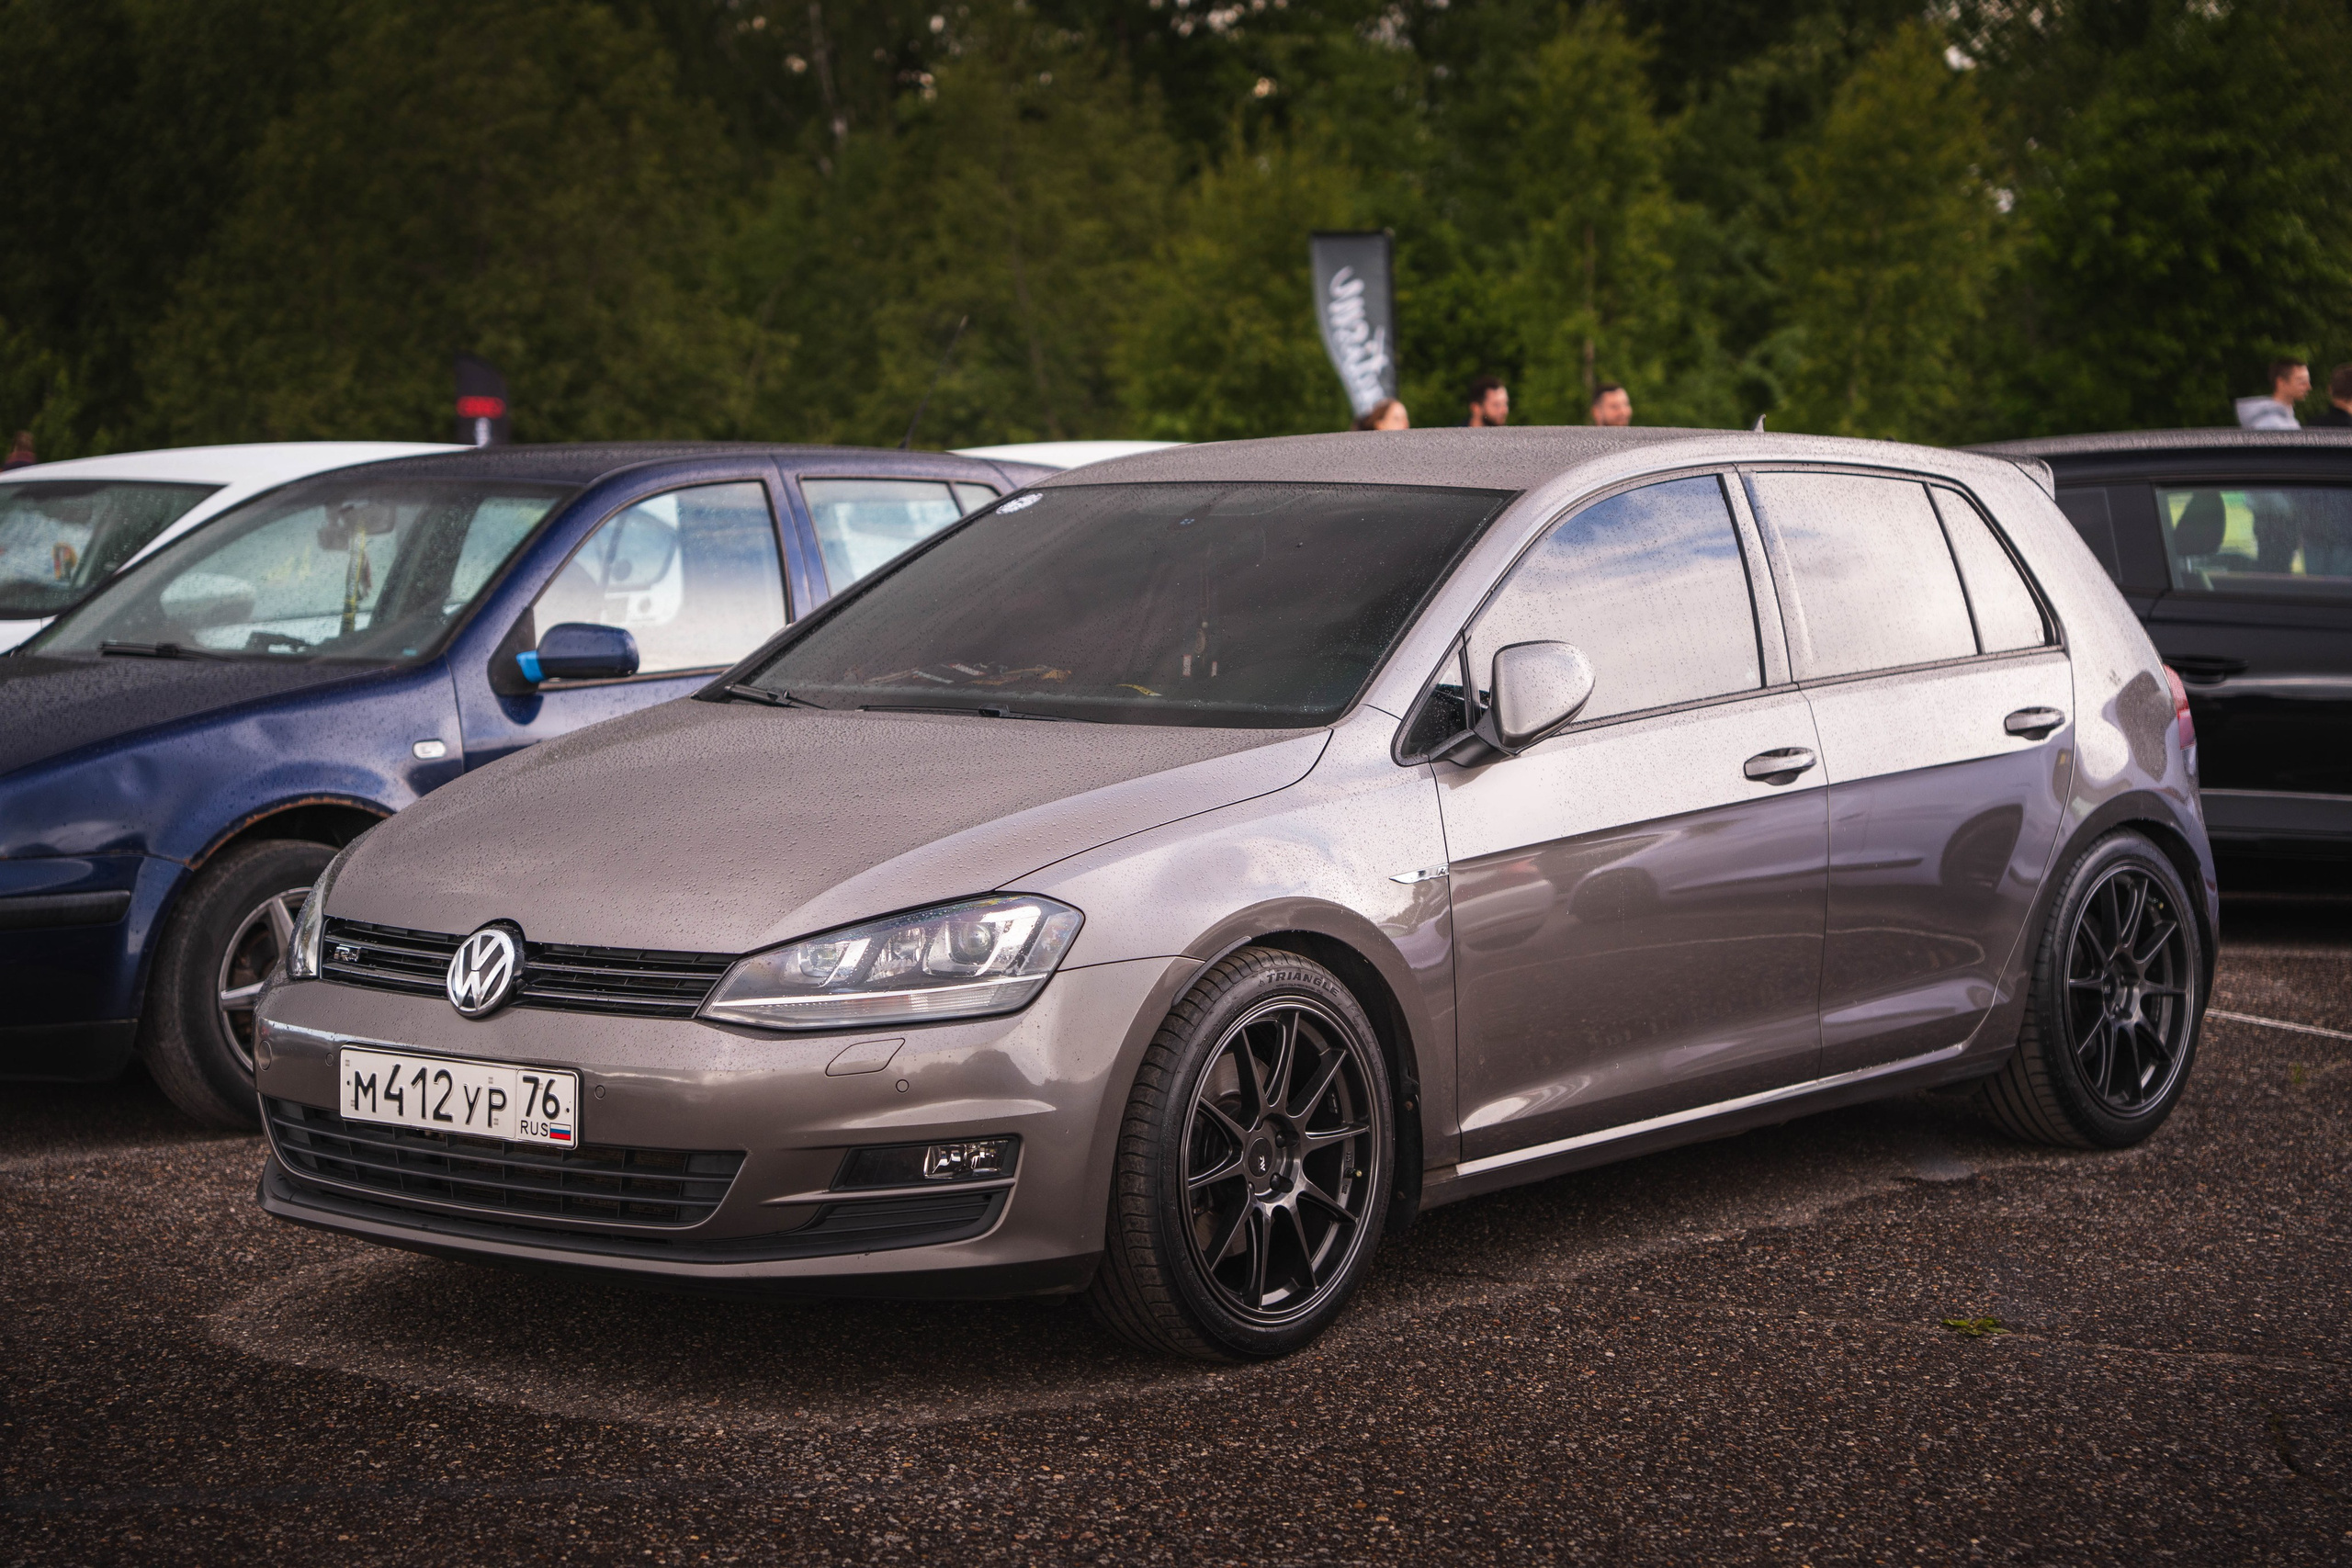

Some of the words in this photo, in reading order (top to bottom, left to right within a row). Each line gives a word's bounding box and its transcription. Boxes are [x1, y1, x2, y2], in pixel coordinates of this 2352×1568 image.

[1266, 970, 1340, 998] TRIANGLE
[522, 1075, 560, 1121] 76
[520, 1119, 548, 1137] RUS
